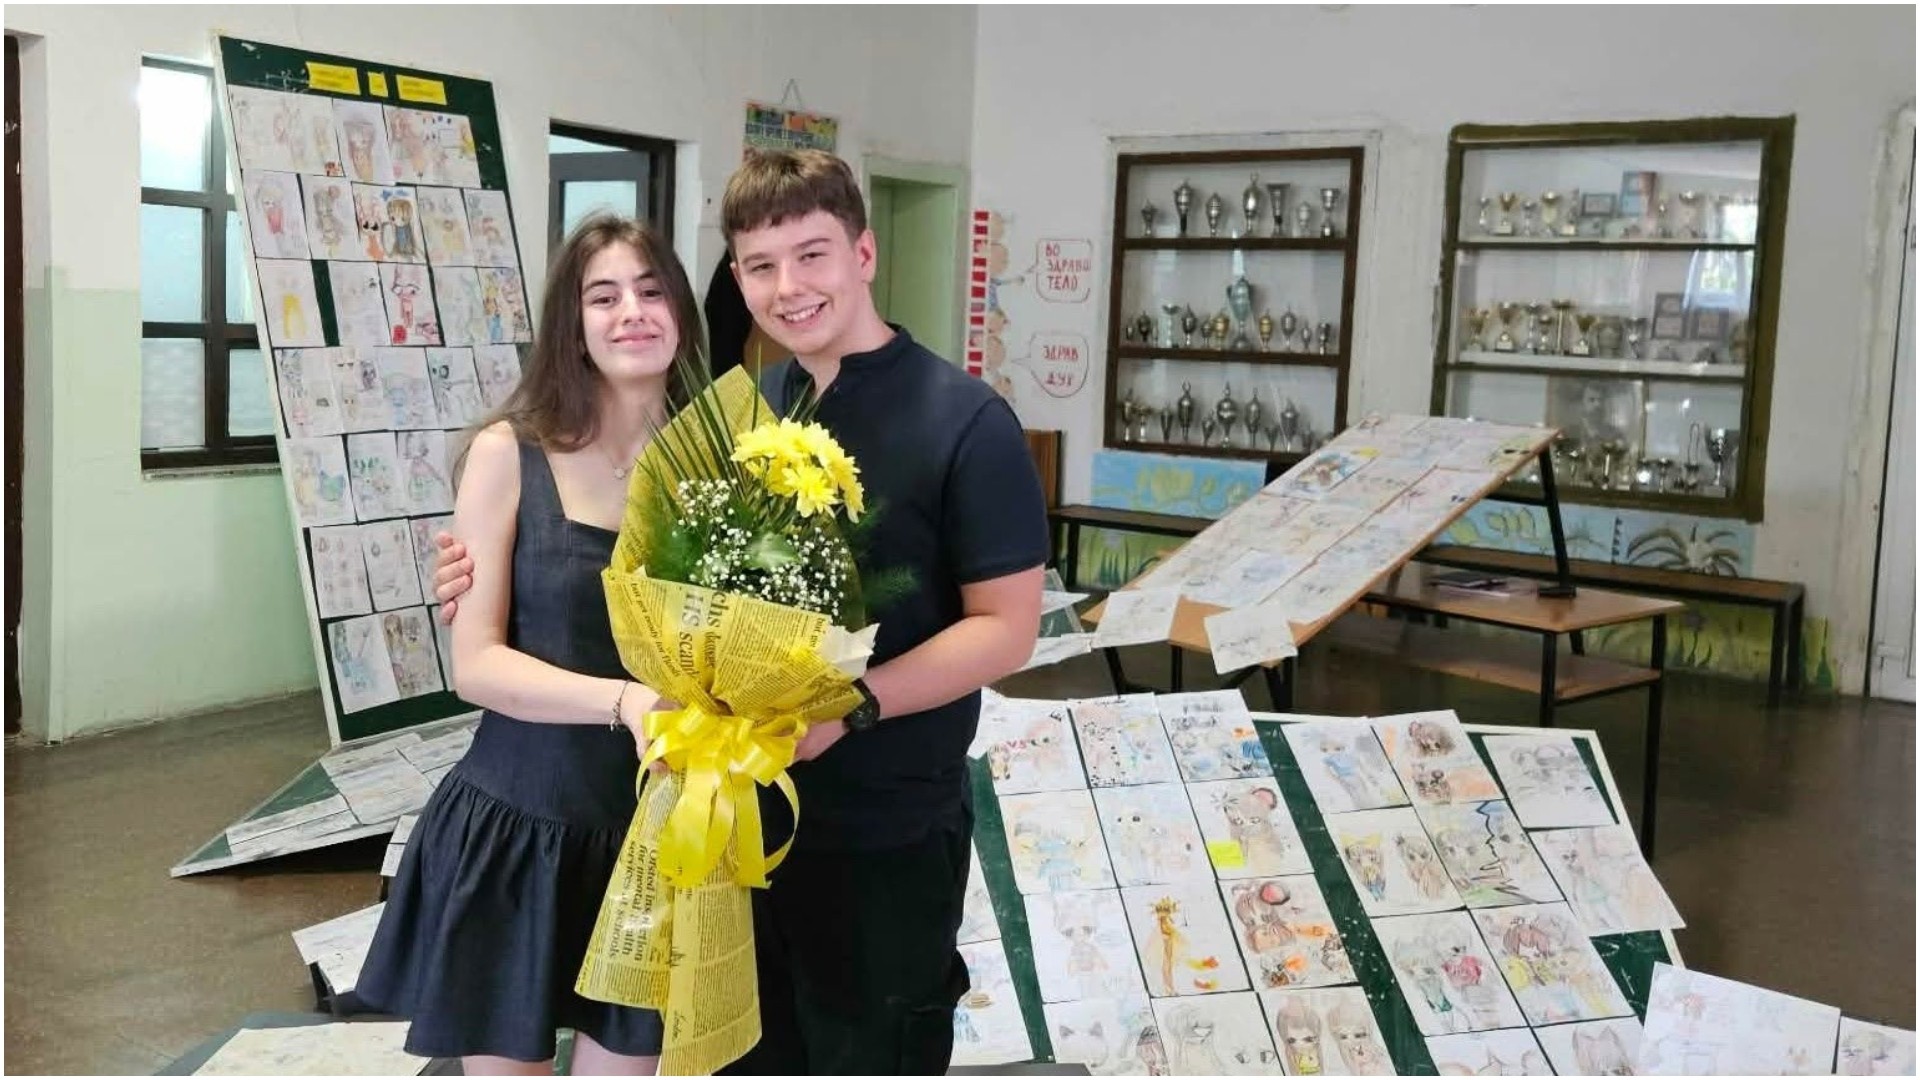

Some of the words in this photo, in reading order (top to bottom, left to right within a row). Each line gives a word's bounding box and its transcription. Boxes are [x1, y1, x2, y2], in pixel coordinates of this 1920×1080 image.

[1045, 243, 1061, 257] ВО
[1047, 275, 1078, 291] ТЕЛО
[1042, 344, 1079, 362] ЗДРАВ
[1045, 371, 1074, 387] ДУХ
[621, 913, 640, 955] halth
[634, 894, 654, 961] inspction
